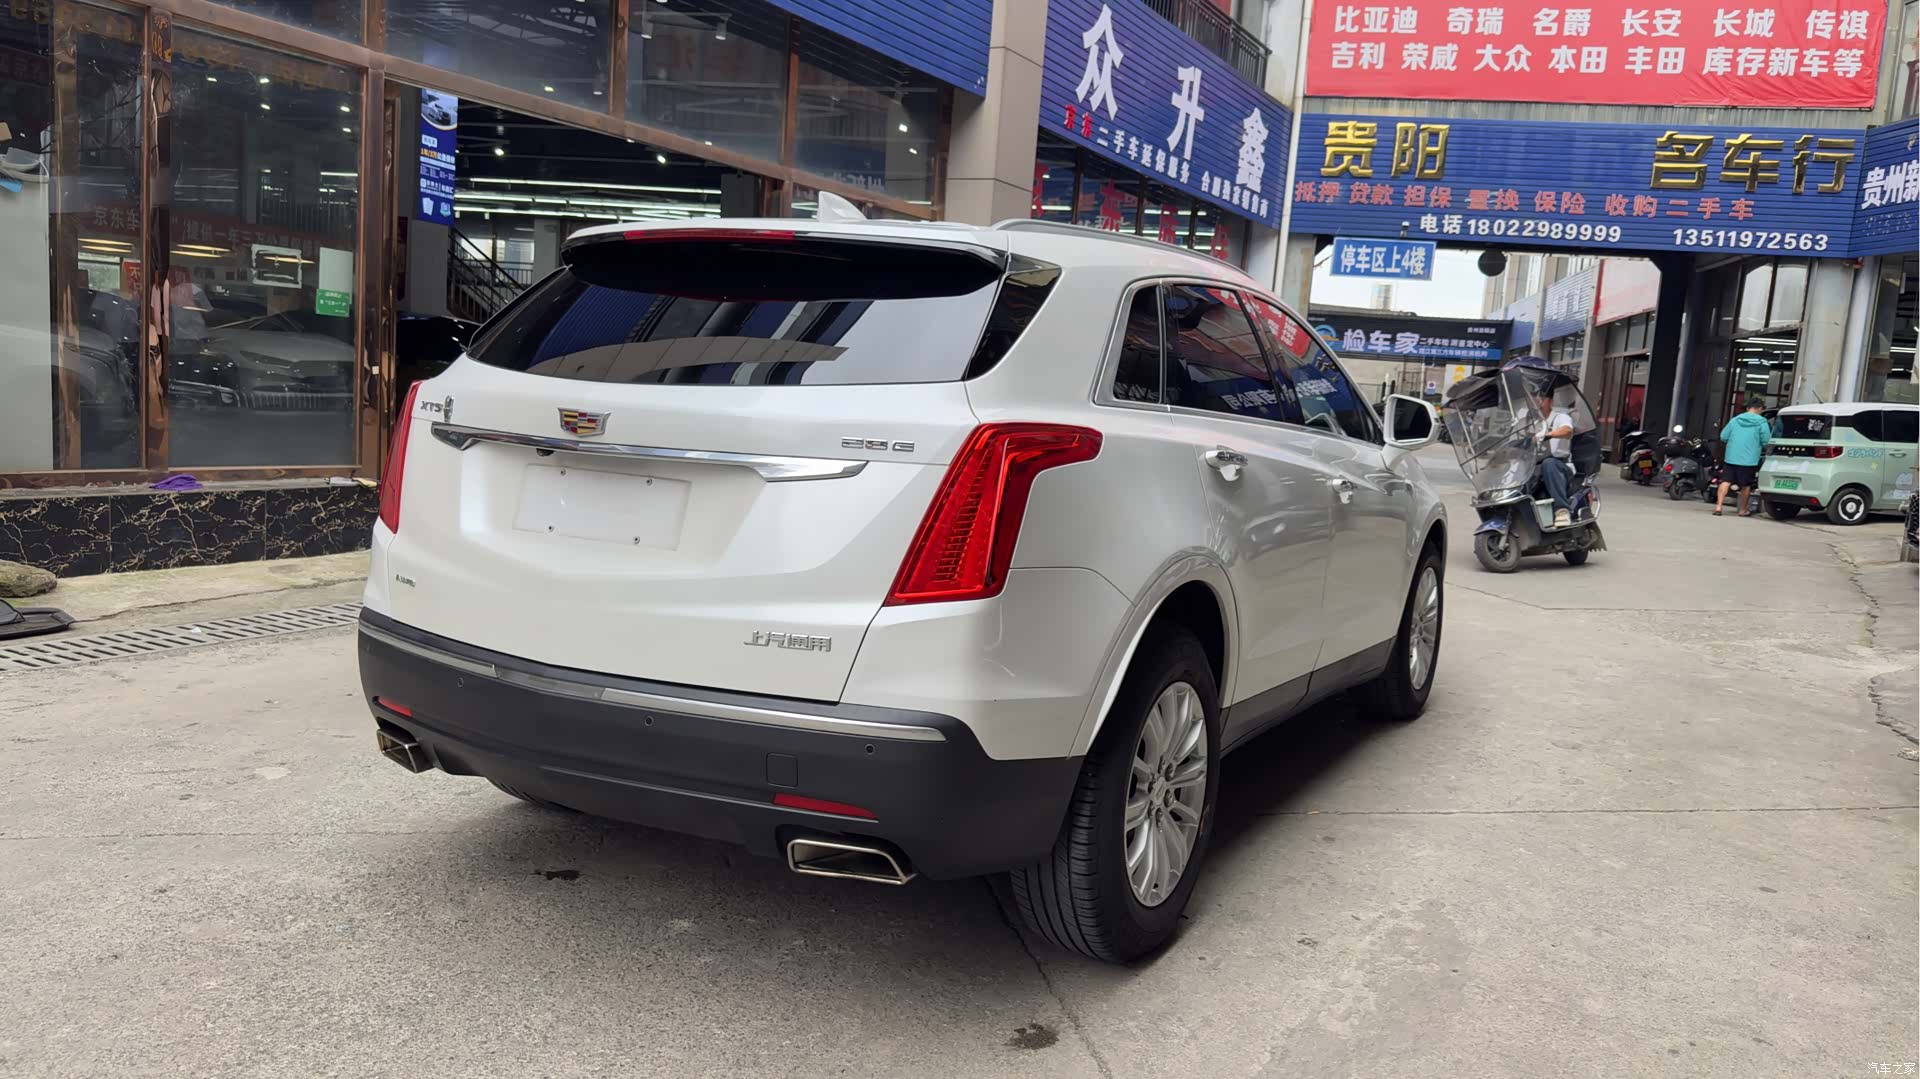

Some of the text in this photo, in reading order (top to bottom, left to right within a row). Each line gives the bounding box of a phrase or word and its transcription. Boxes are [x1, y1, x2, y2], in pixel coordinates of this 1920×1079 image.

[1334, 5, 1870, 40] 比亚迪 奇瑞 名爵 长安 长城 传祺
[1331, 41, 1865, 78] 吉利 荣威 大众 本田 丰田 库存新车等
[1320, 120, 1856, 194] 贵阳 名车行
[1294, 180, 1755, 221] 抵押 贷款 担保 置换 保险 收购二手车
[1673, 227, 1829, 251] 13511972563
[1340, 243, 1426, 276] 停车区上4楼
[1341, 328, 1420, 355] 检车家
[420, 400, 444, 413] XT5
[743, 630, 832, 653] 上汽通用
